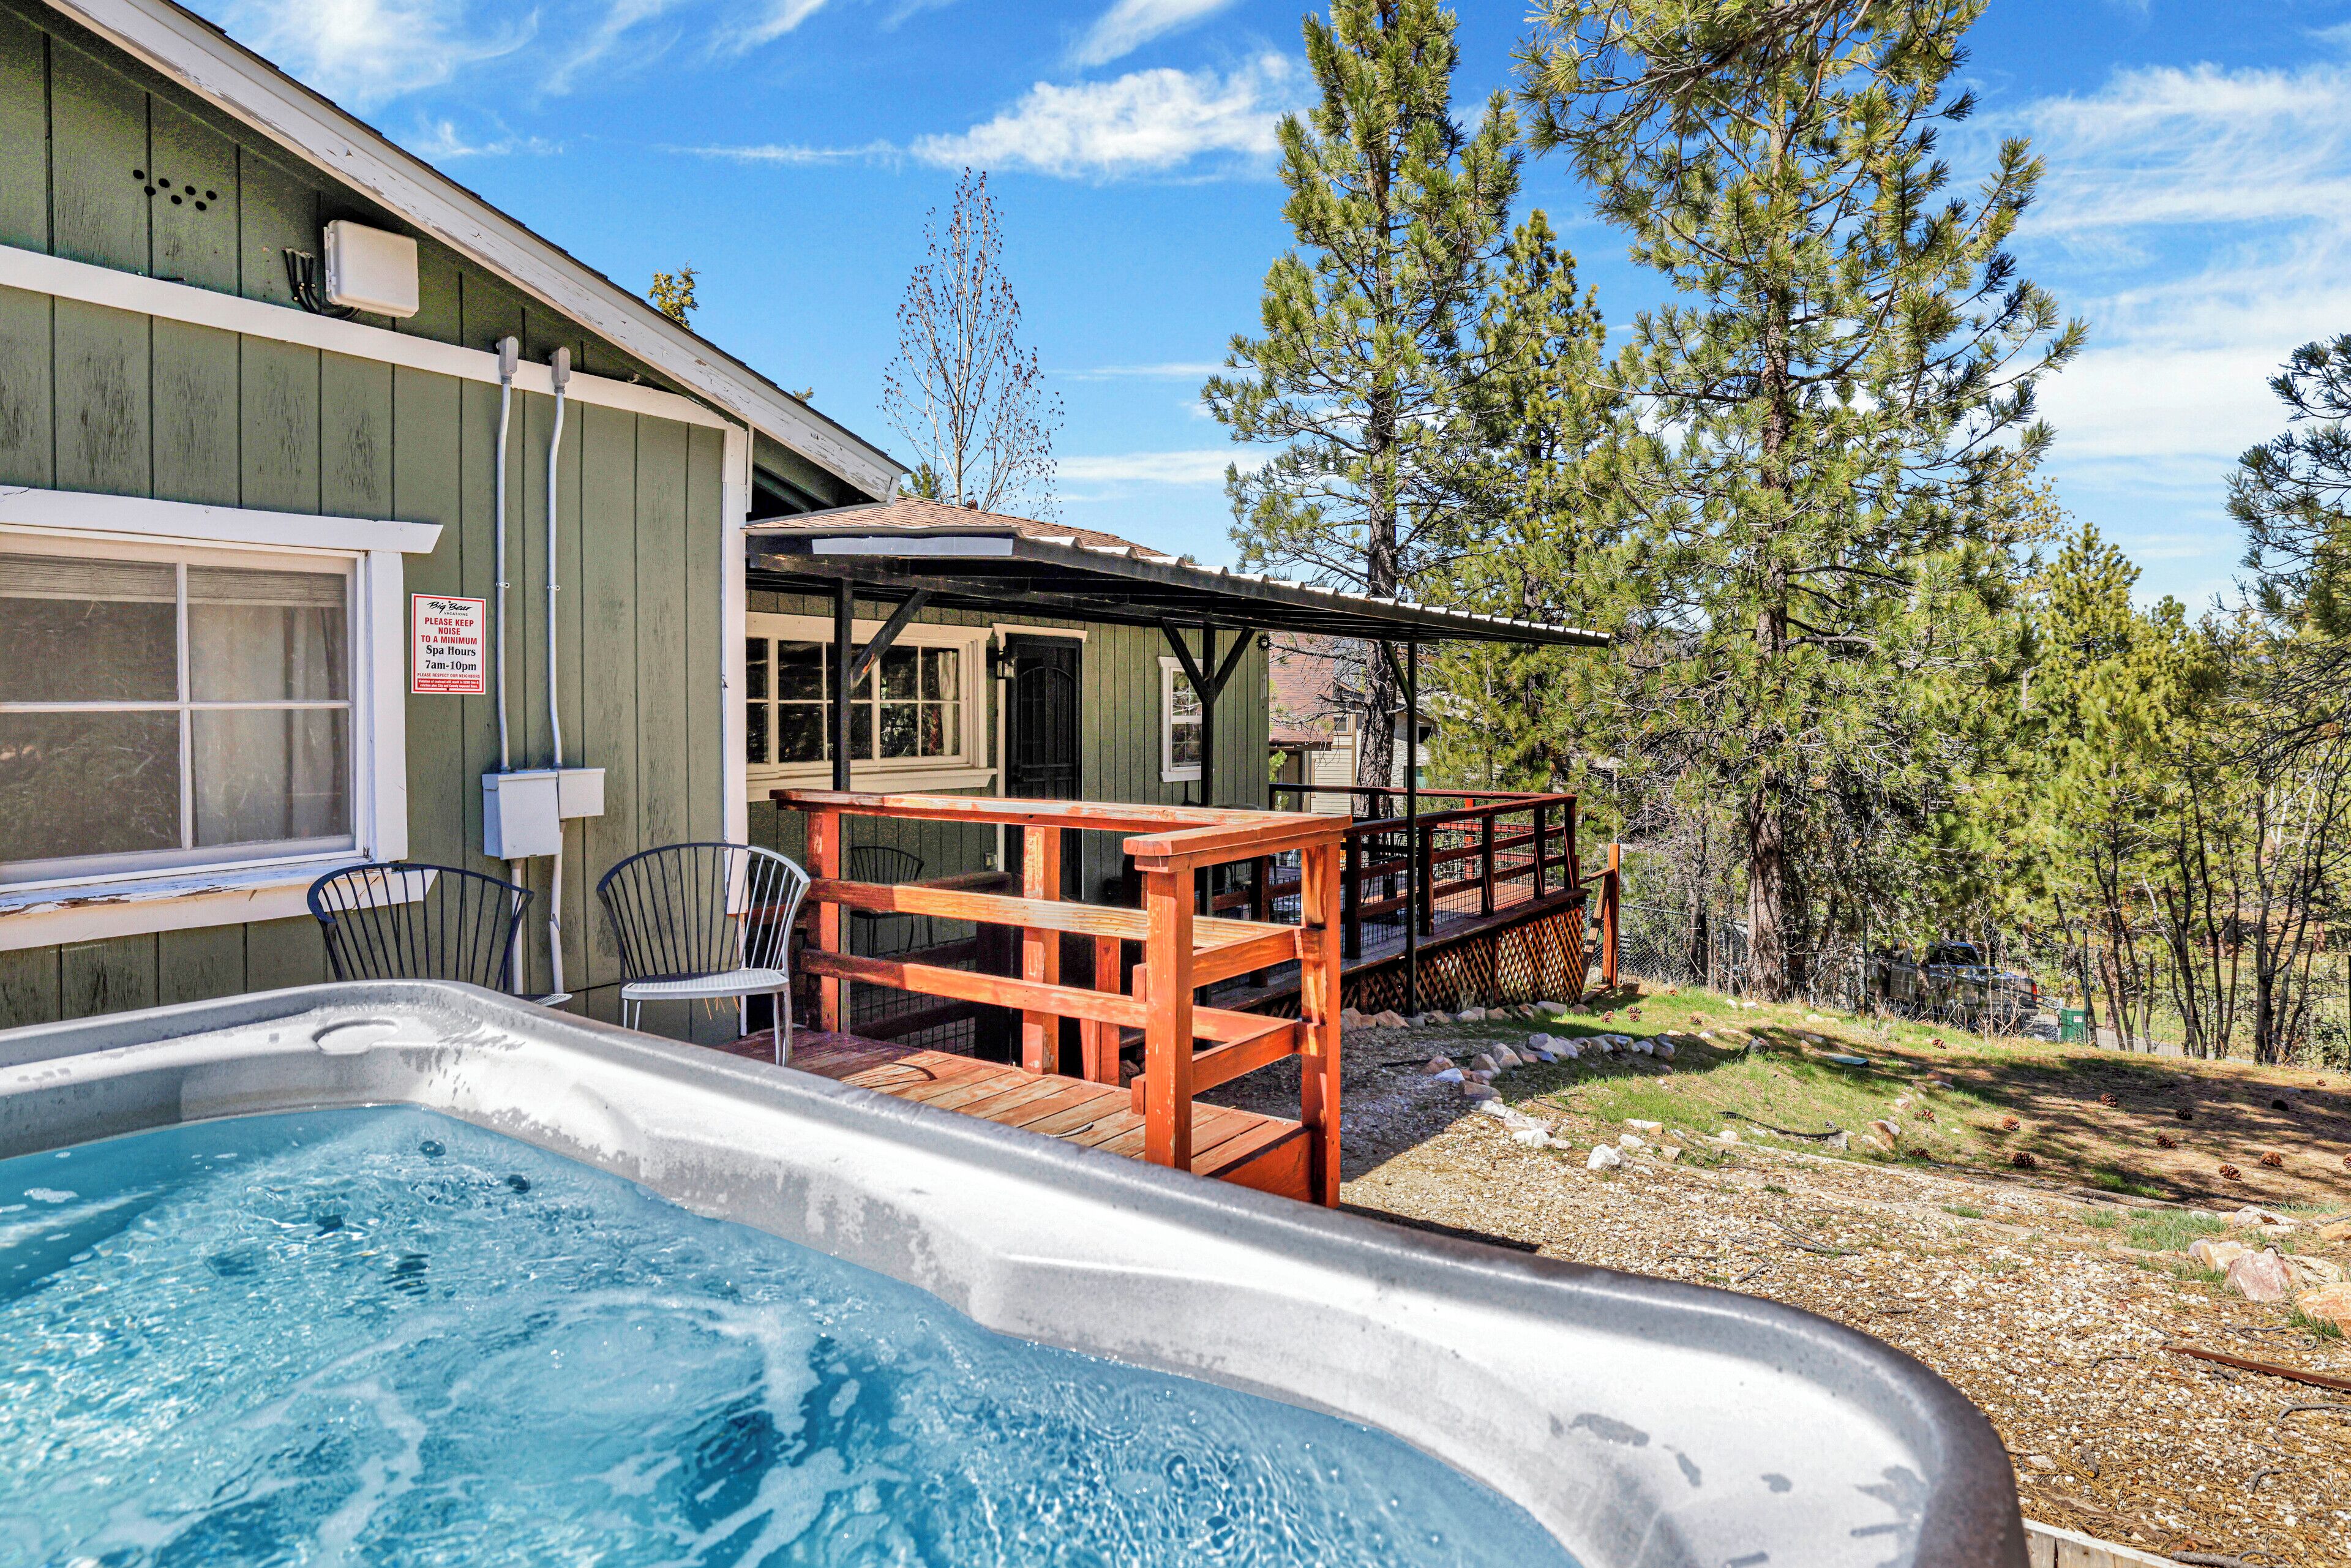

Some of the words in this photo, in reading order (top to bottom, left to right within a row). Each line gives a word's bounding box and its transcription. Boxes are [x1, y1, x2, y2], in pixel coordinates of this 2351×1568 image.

[427, 601, 446, 615] Big
[424, 617, 452, 626] PLEASE
[426, 645, 444, 656] Spa
[448, 647, 476, 656] Hours
[425, 660, 476, 672] 7am-10pm
